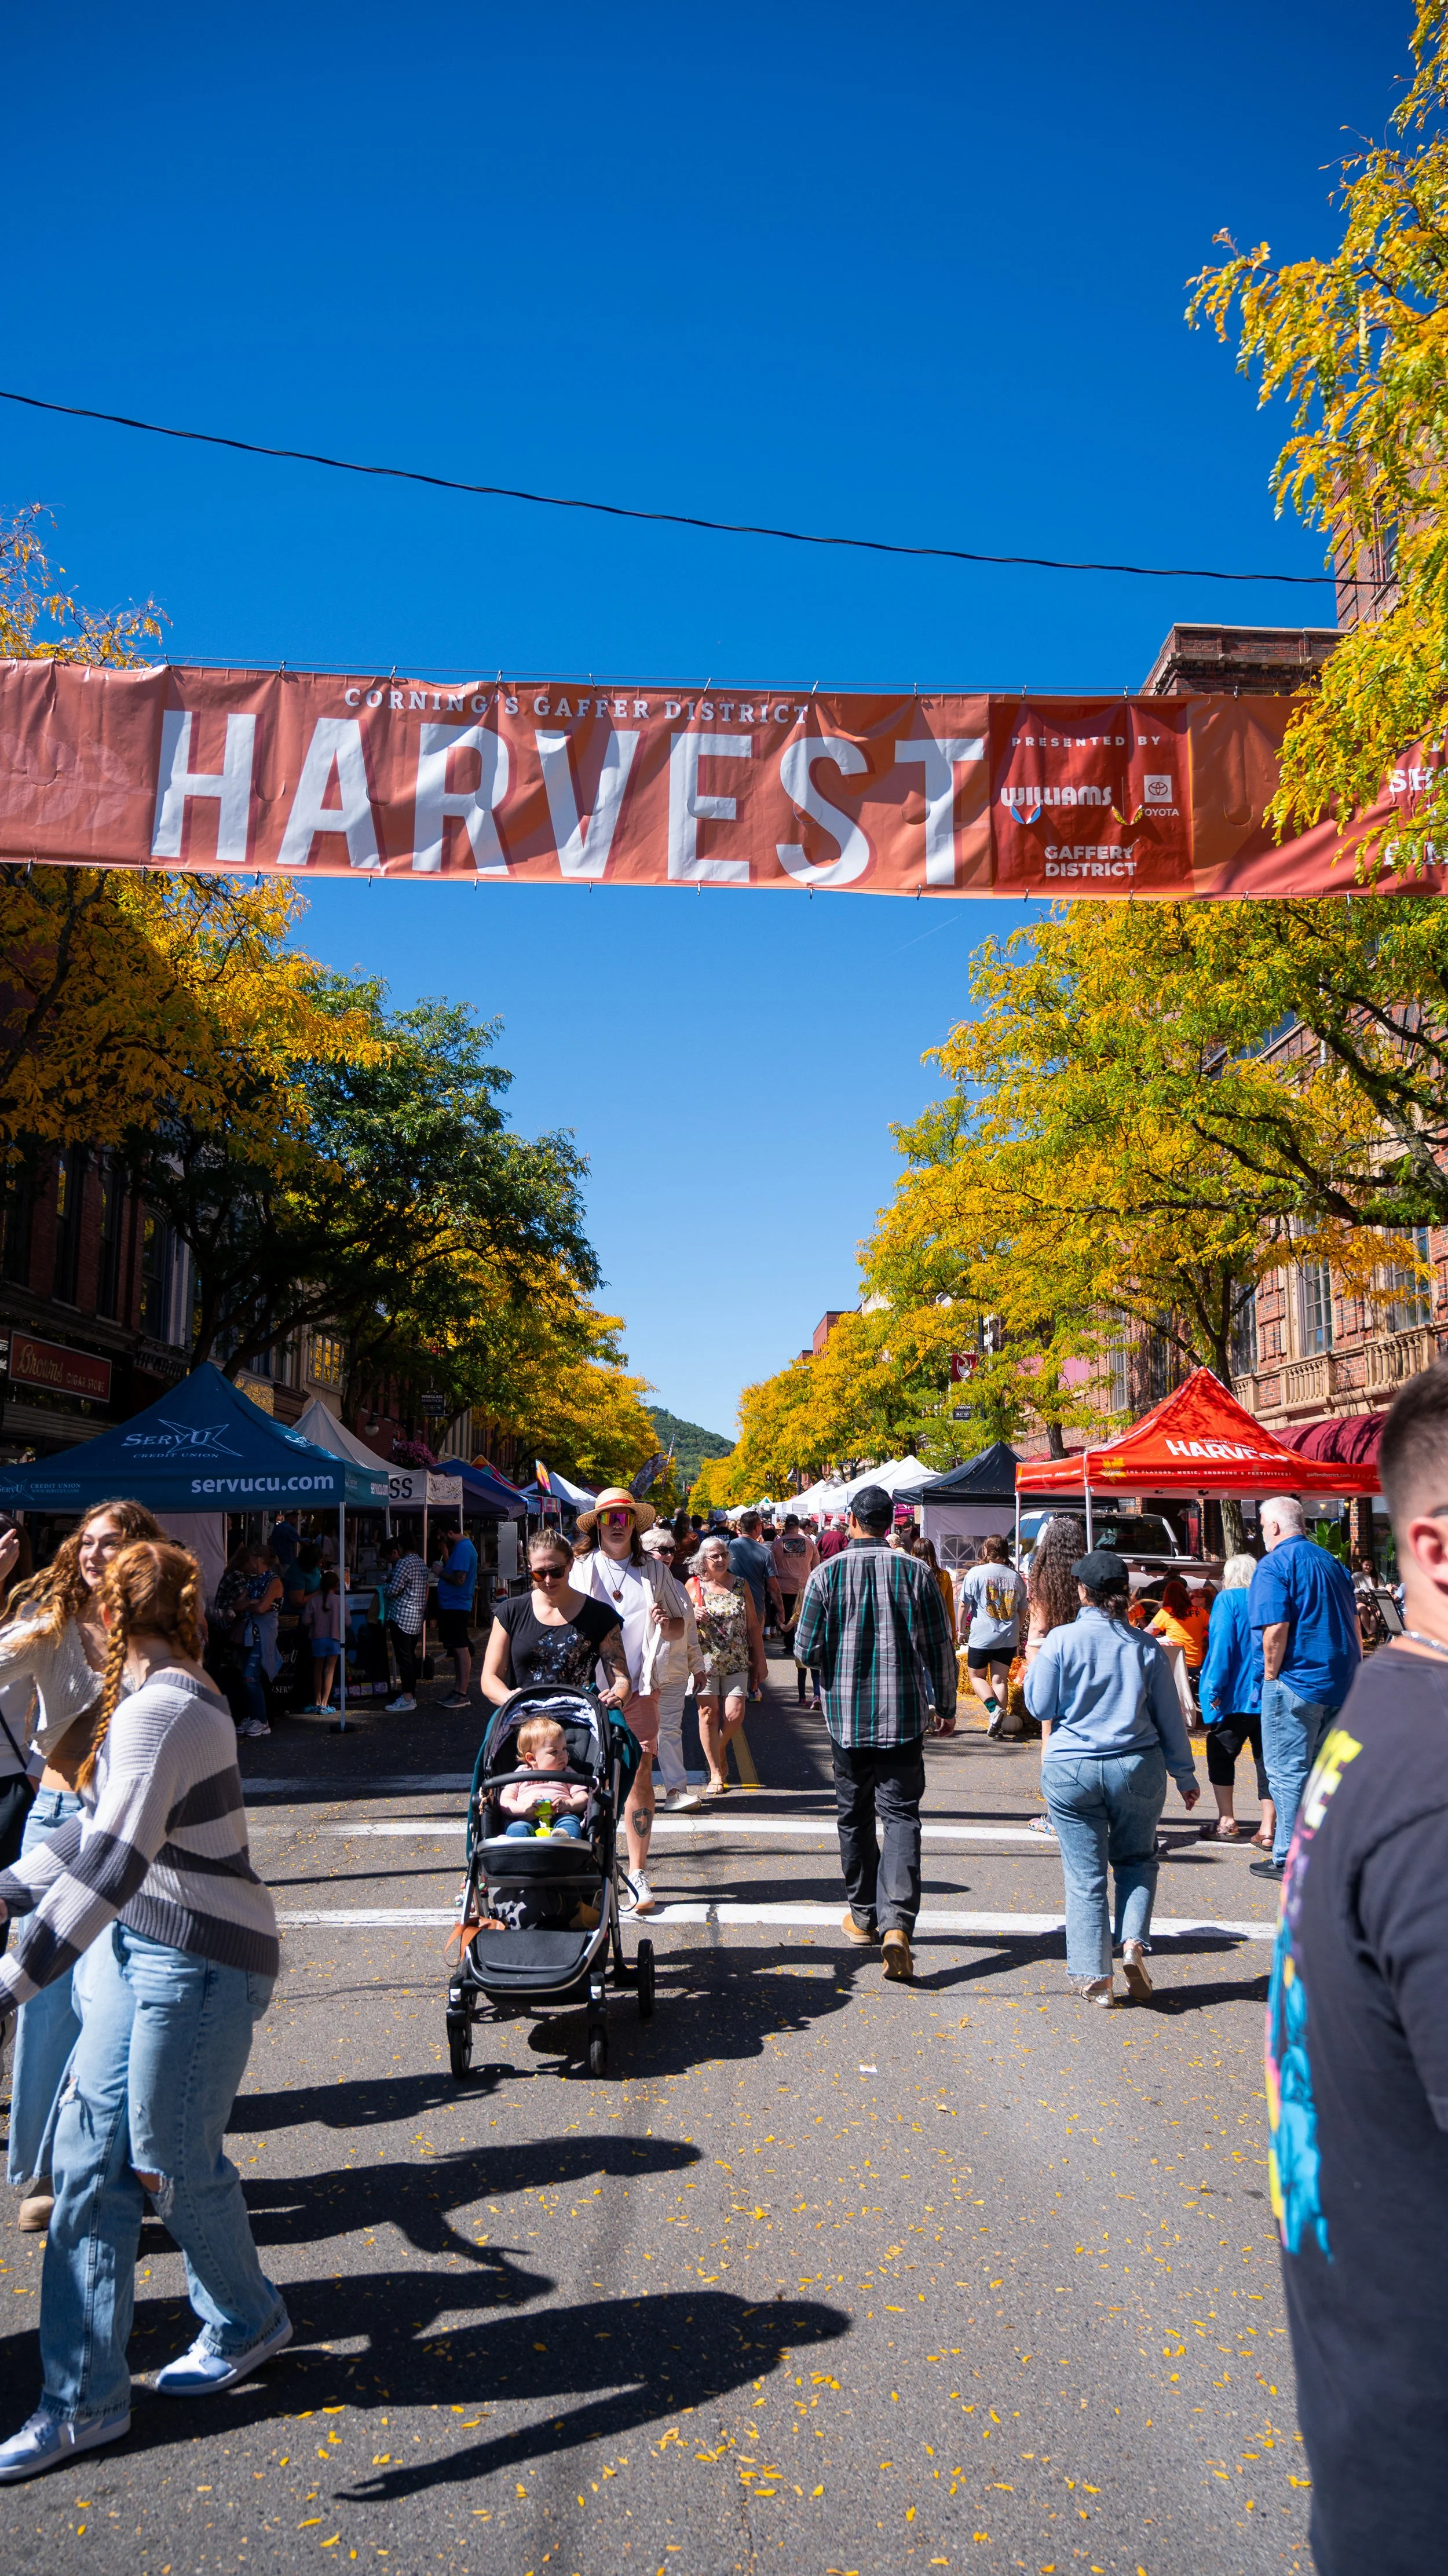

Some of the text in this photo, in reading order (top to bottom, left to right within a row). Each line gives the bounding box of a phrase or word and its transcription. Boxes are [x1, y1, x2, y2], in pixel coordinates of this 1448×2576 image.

[345, 688, 809, 724] CORNING'S GAFFER DISTRICT
[1012, 736, 1161, 747] PRESENTED BY
[151, 710, 983, 886] HARVEST
[1000, 786, 1112, 807] WILLIAMS
[1044, 845, 1132, 860] GAFFER
[1045, 862, 1137, 877] DISTRICT
[66, 1372, 87, 1388] CIGAR
[87, 1378, 105, 1393] STORE
[191, 1475, 334, 1493] servucu.com
